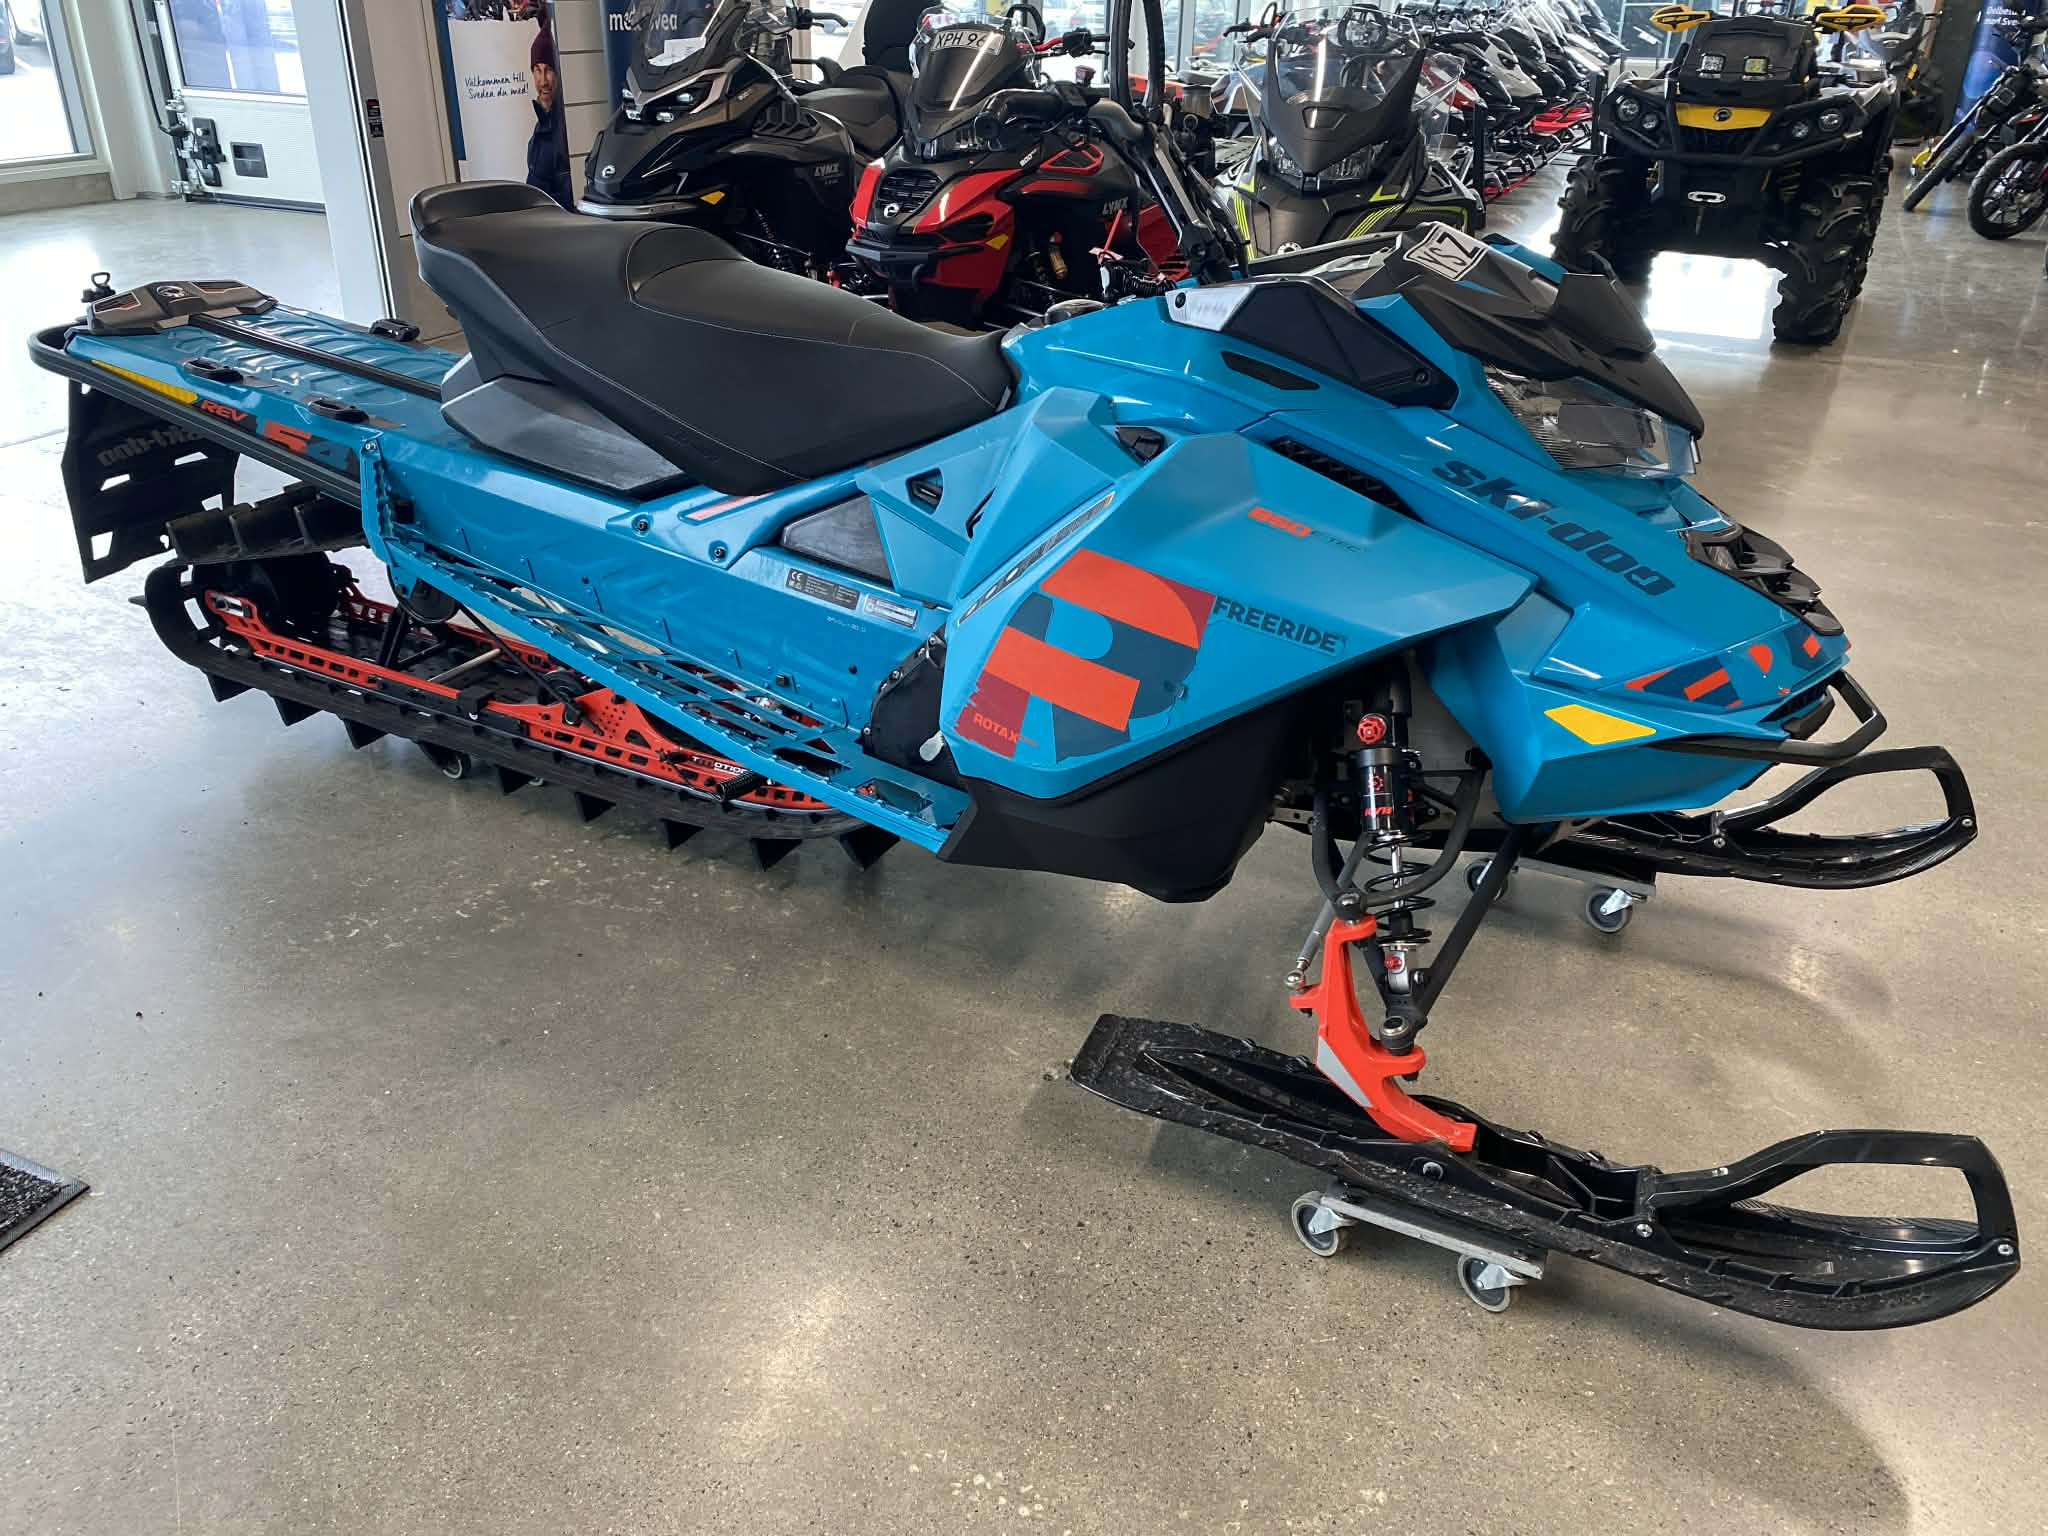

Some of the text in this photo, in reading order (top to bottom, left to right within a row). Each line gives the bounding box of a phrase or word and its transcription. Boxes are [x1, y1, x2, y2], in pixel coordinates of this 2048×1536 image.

[649, 12, 678, 31] vea
[935, 31, 963, 49] XPH
[814, 163, 840, 177] LYNX
[1102, 197, 1128, 216] LYNX
[200, 399, 249, 422] REV
[1211, 595, 1340, 653] FREERIDE
[973, 712, 1020, 744] ROTAX
